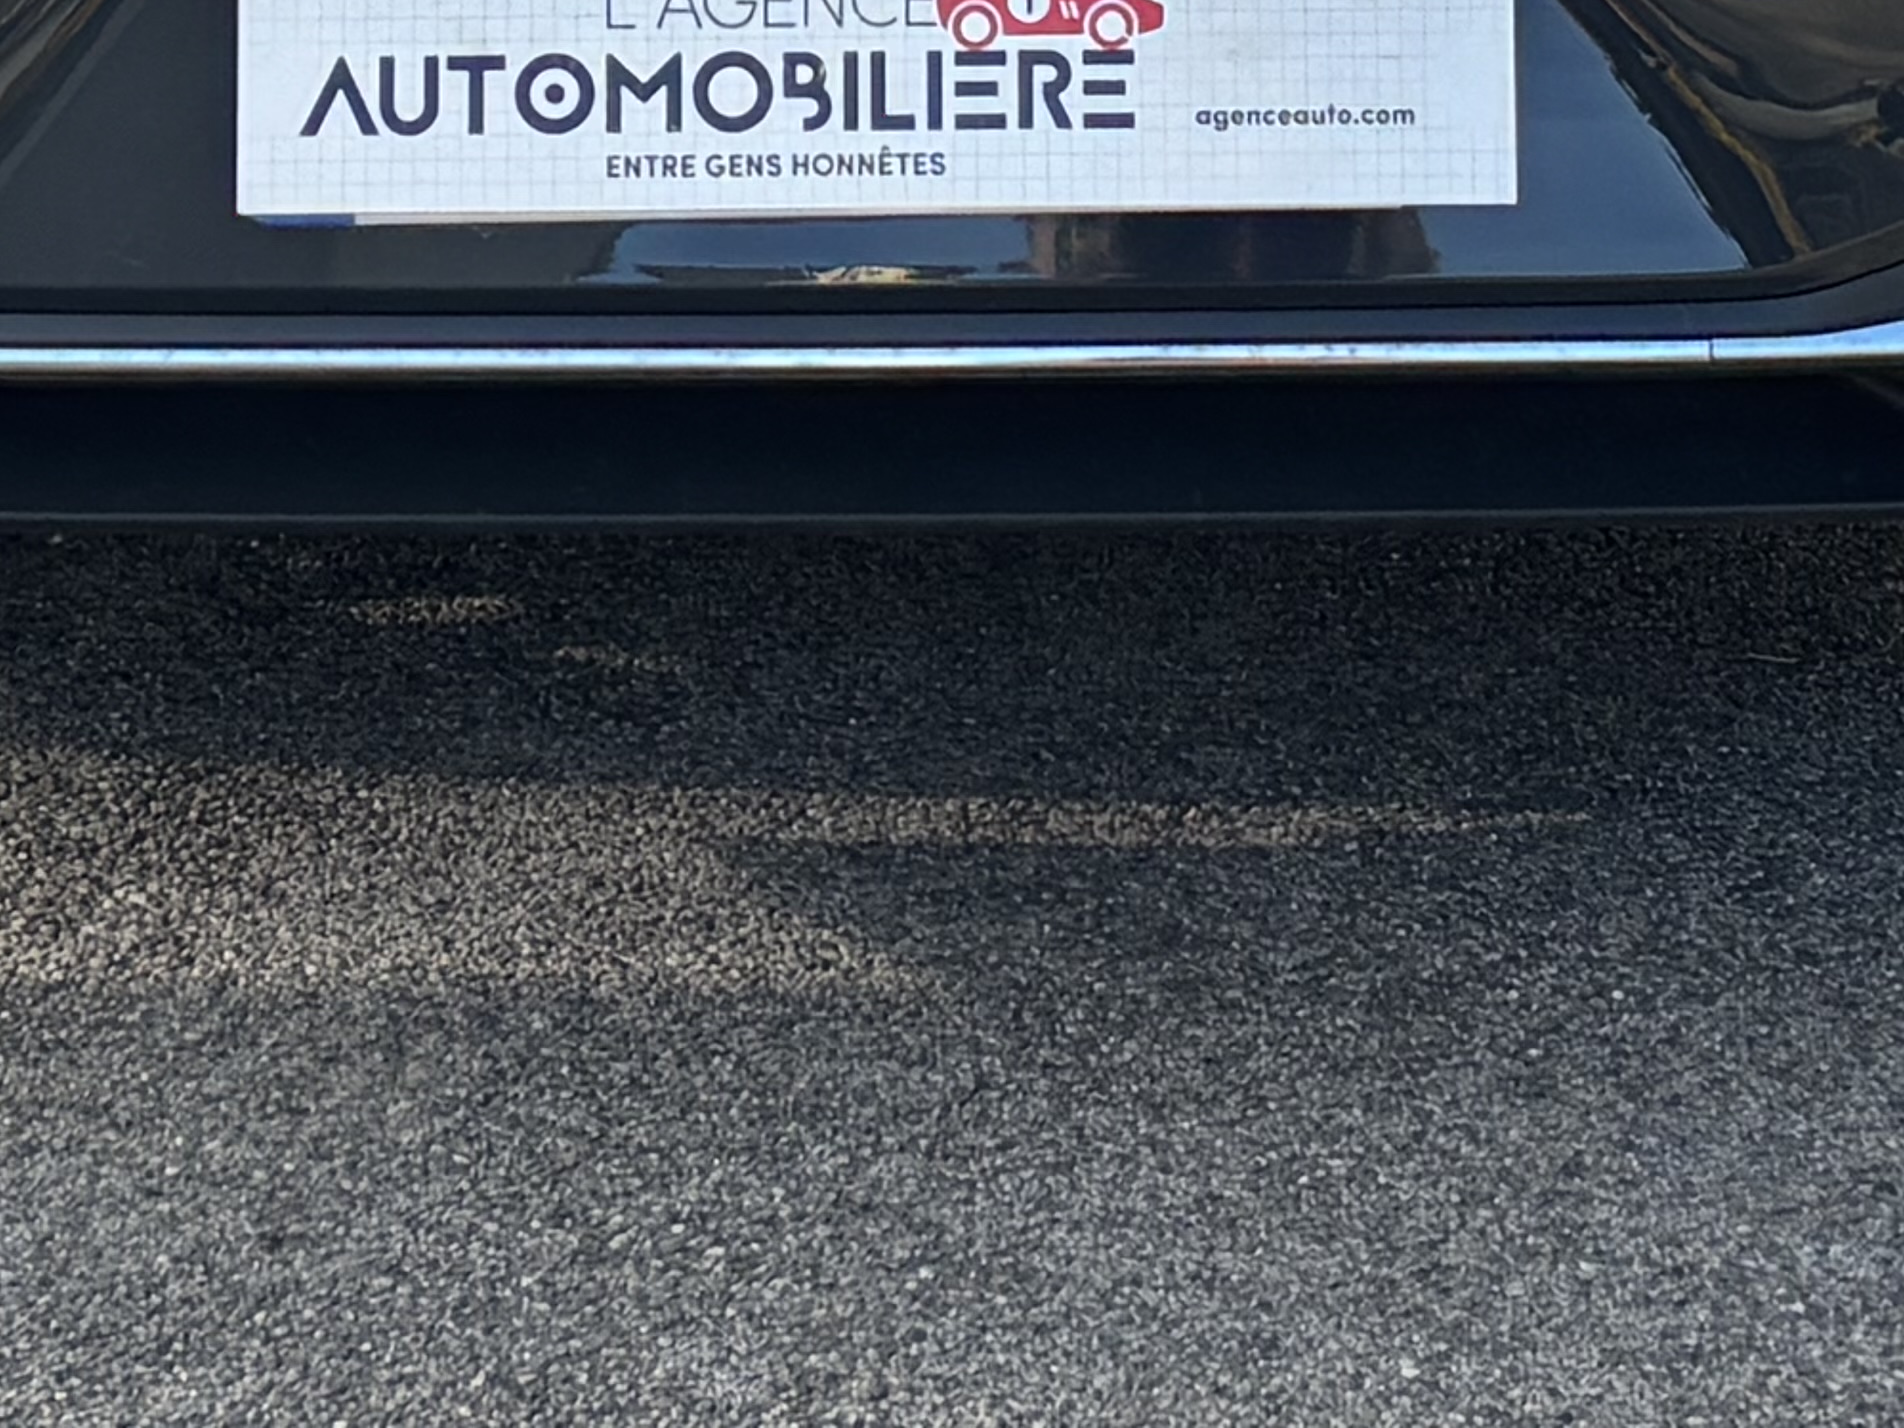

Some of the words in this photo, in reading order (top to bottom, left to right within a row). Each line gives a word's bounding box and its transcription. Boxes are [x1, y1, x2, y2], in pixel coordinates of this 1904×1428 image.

[1194, 103, 1416, 132] agenceauto.com
[605, 153, 696, 178] ENTRE
[704, 153, 782, 178] GENS
[791, 144, 947, 177] HONNÊTES
